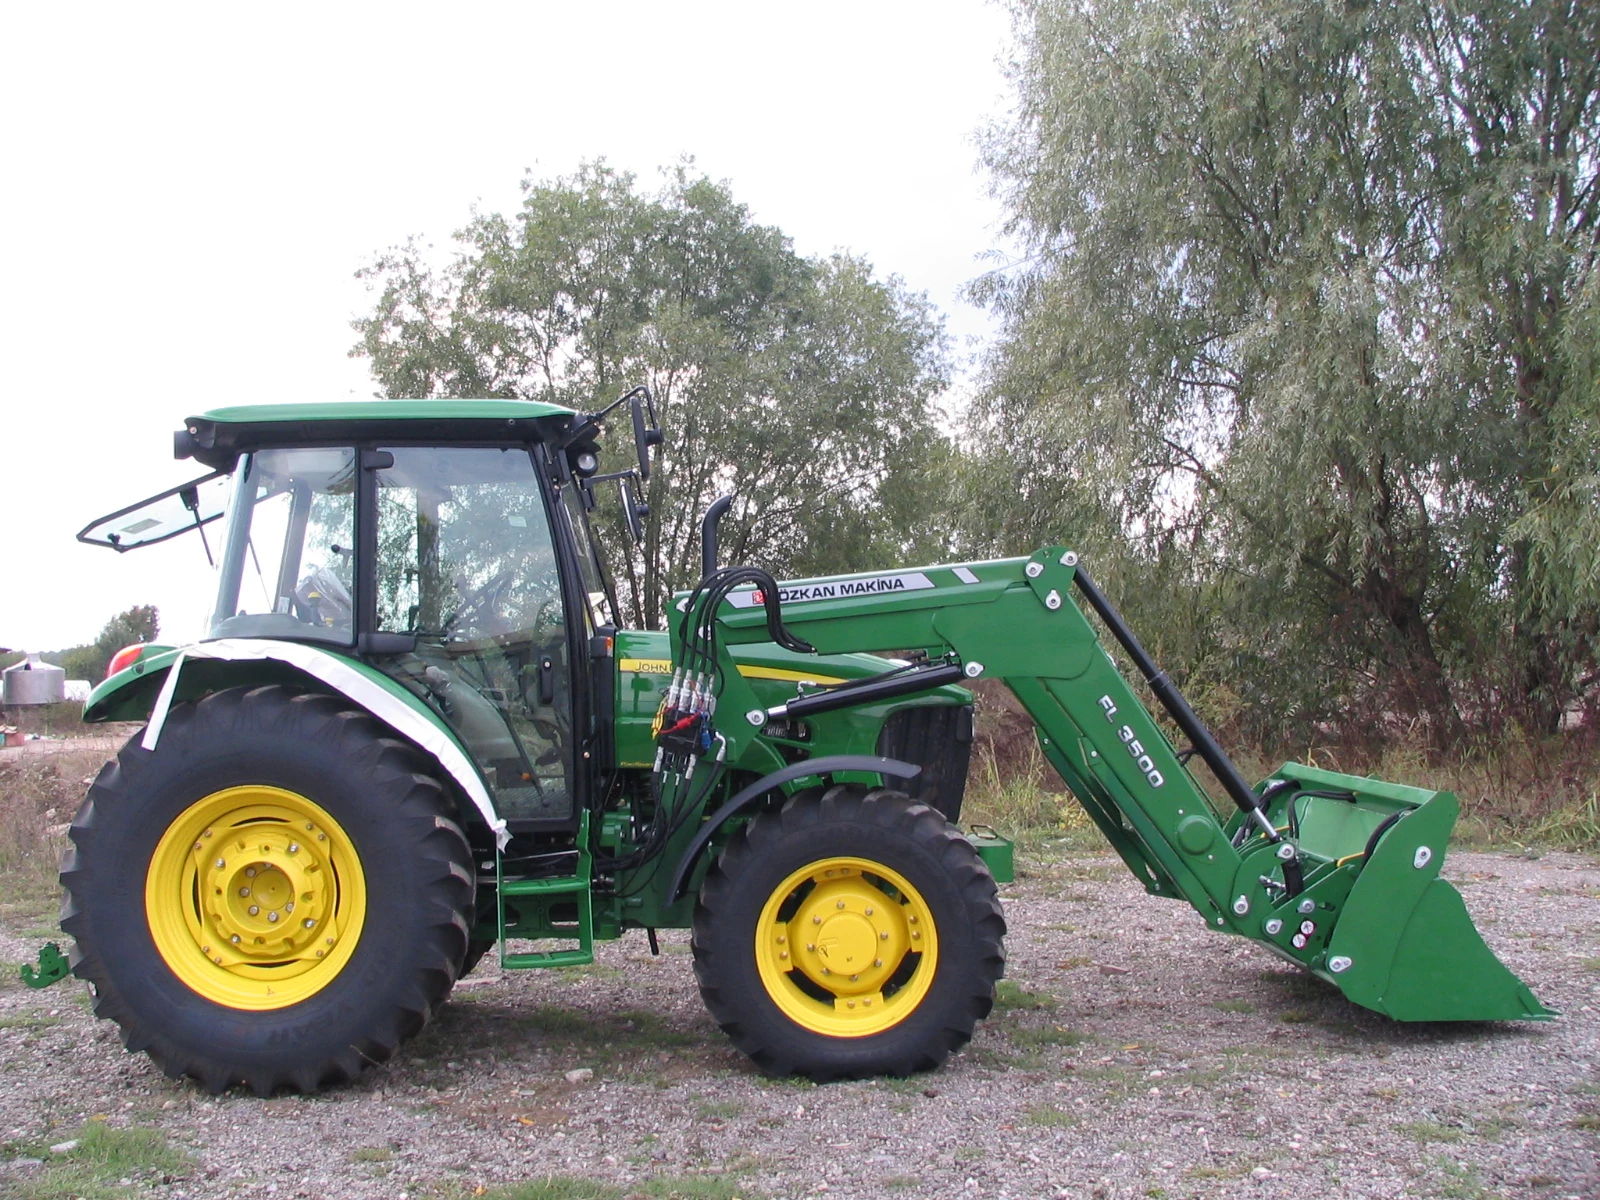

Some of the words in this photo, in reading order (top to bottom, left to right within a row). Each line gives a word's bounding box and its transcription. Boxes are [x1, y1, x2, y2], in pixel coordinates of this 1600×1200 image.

[840, 578, 905, 596] MAKİNA
[634, 661, 668, 672] JOHN
[1097, 694, 1118, 724] FL
[1117, 724, 1165, 788] 3500
